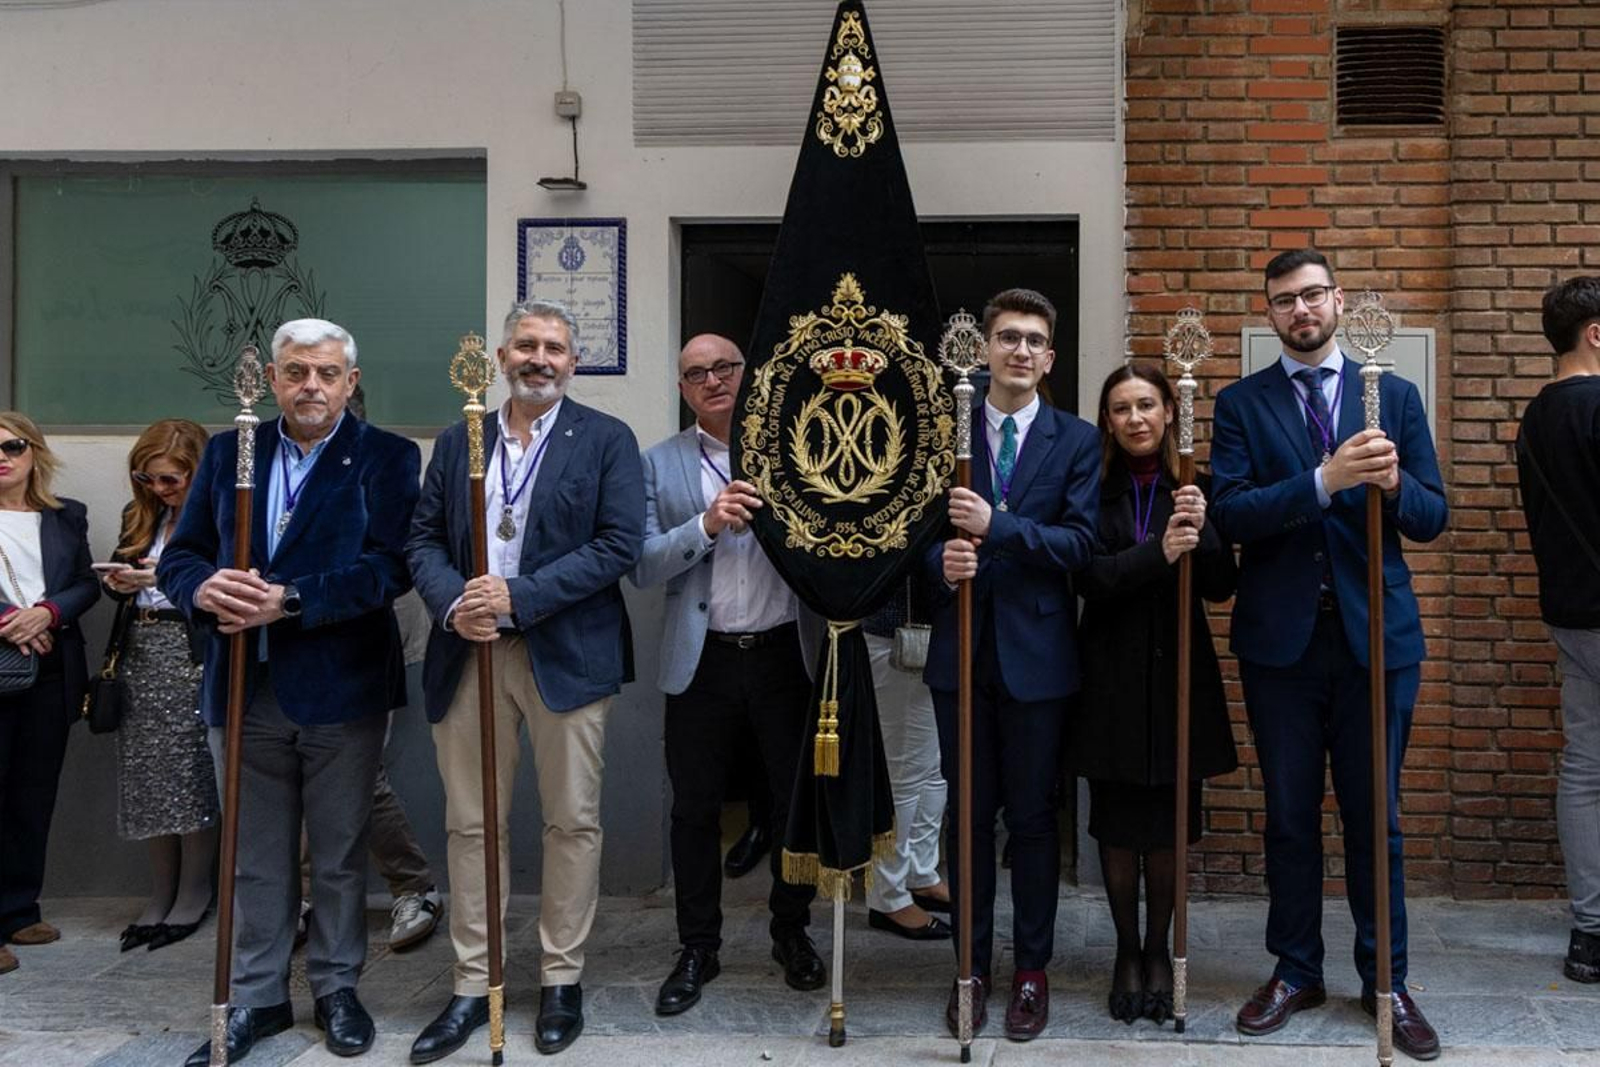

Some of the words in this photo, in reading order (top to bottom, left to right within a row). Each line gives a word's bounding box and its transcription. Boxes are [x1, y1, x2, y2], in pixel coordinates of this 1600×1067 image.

[820, 326, 855, 345] CRISTO
[857, 328, 900, 358] YACENTE
[895, 351, 909, 362] Y
[779, 363, 798, 382] DEL
[900, 360, 928, 401] SIERVOS
[916, 403, 931, 417] DE
[916, 419, 931, 448] NTRA
[768, 440, 783, 470] REAL
[911, 449, 929, 471] SRA
[773, 471, 786, 480] Y
[905, 472, 921, 489] DE
[898, 486, 915, 501] LA
[862, 495, 905, 530] SOLEDAD
